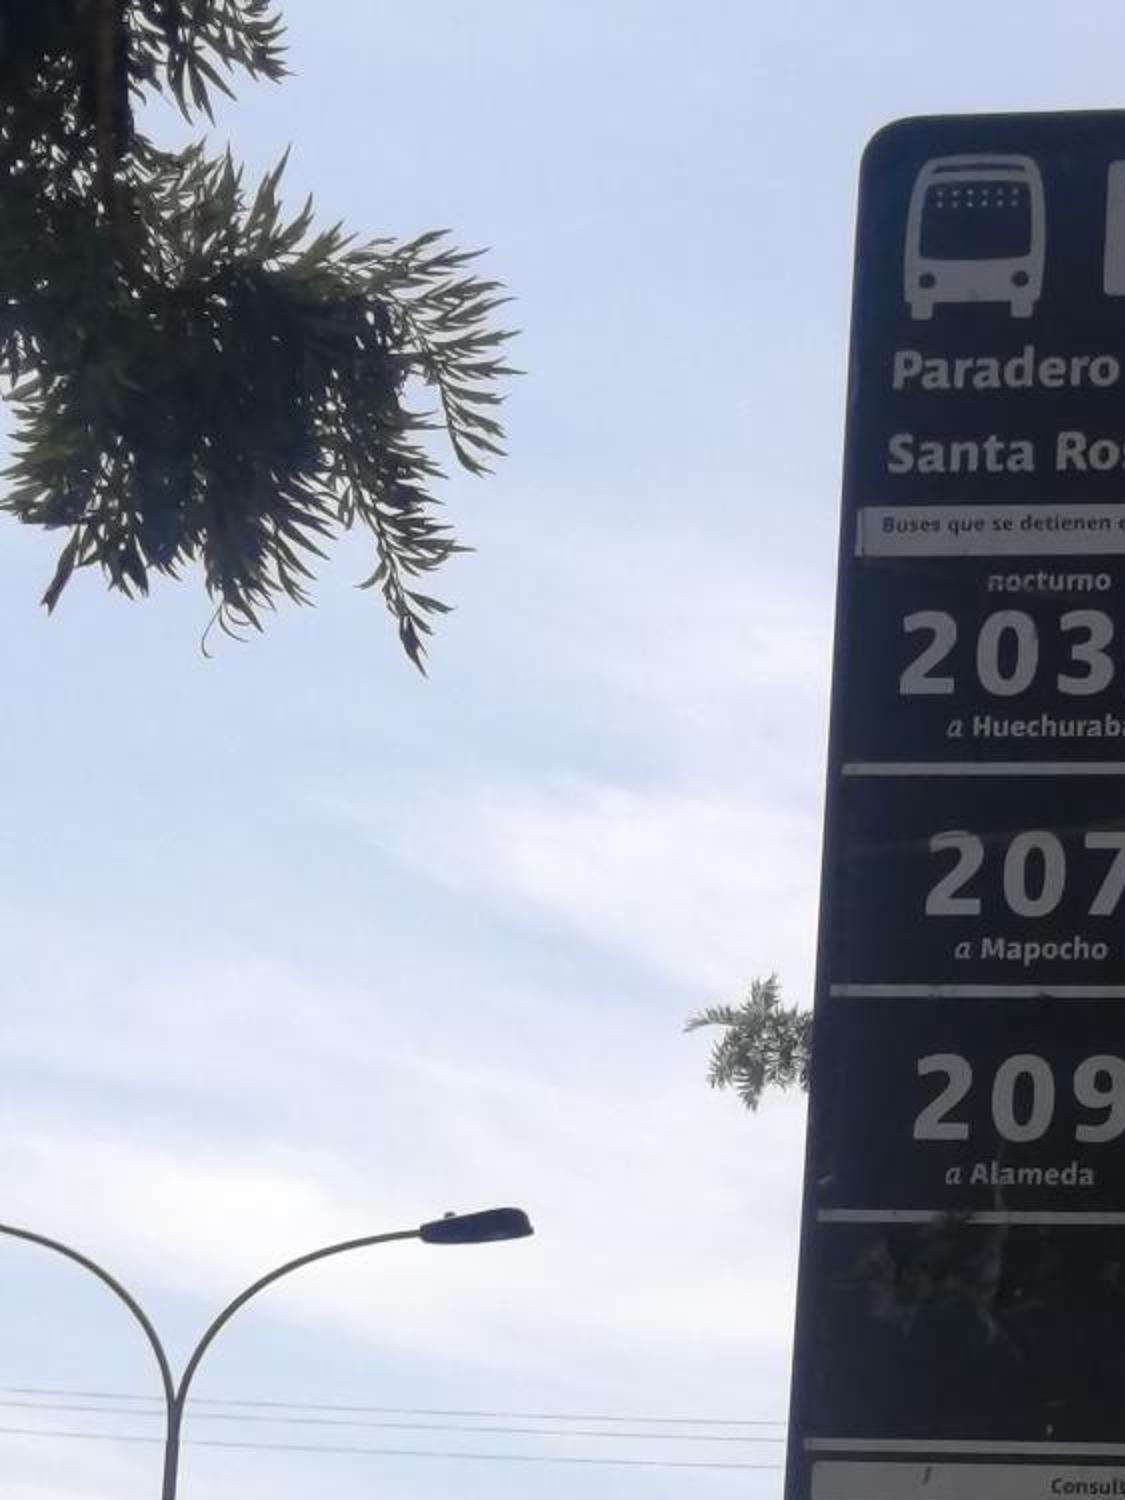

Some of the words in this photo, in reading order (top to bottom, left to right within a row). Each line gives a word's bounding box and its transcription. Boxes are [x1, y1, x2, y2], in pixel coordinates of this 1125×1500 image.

[893, 345, 1119, 390] Paradero
[887, 431, 1034, 474] Santa
[883, 516, 940, 534] Buses
[948, 517, 984, 536] que
[993, 517, 1011, 531] se
[1020, 514, 1111, 531] detienen
[988, 570, 1112, 592] nocturno
[947, 718, 963, 738] a
[955, 942, 971, 960] a
[981, 936, 1109, 966] Mapocho
[945, 1166, 962, 1185] a
[969, 1160, 1095, 1185] Alameda
